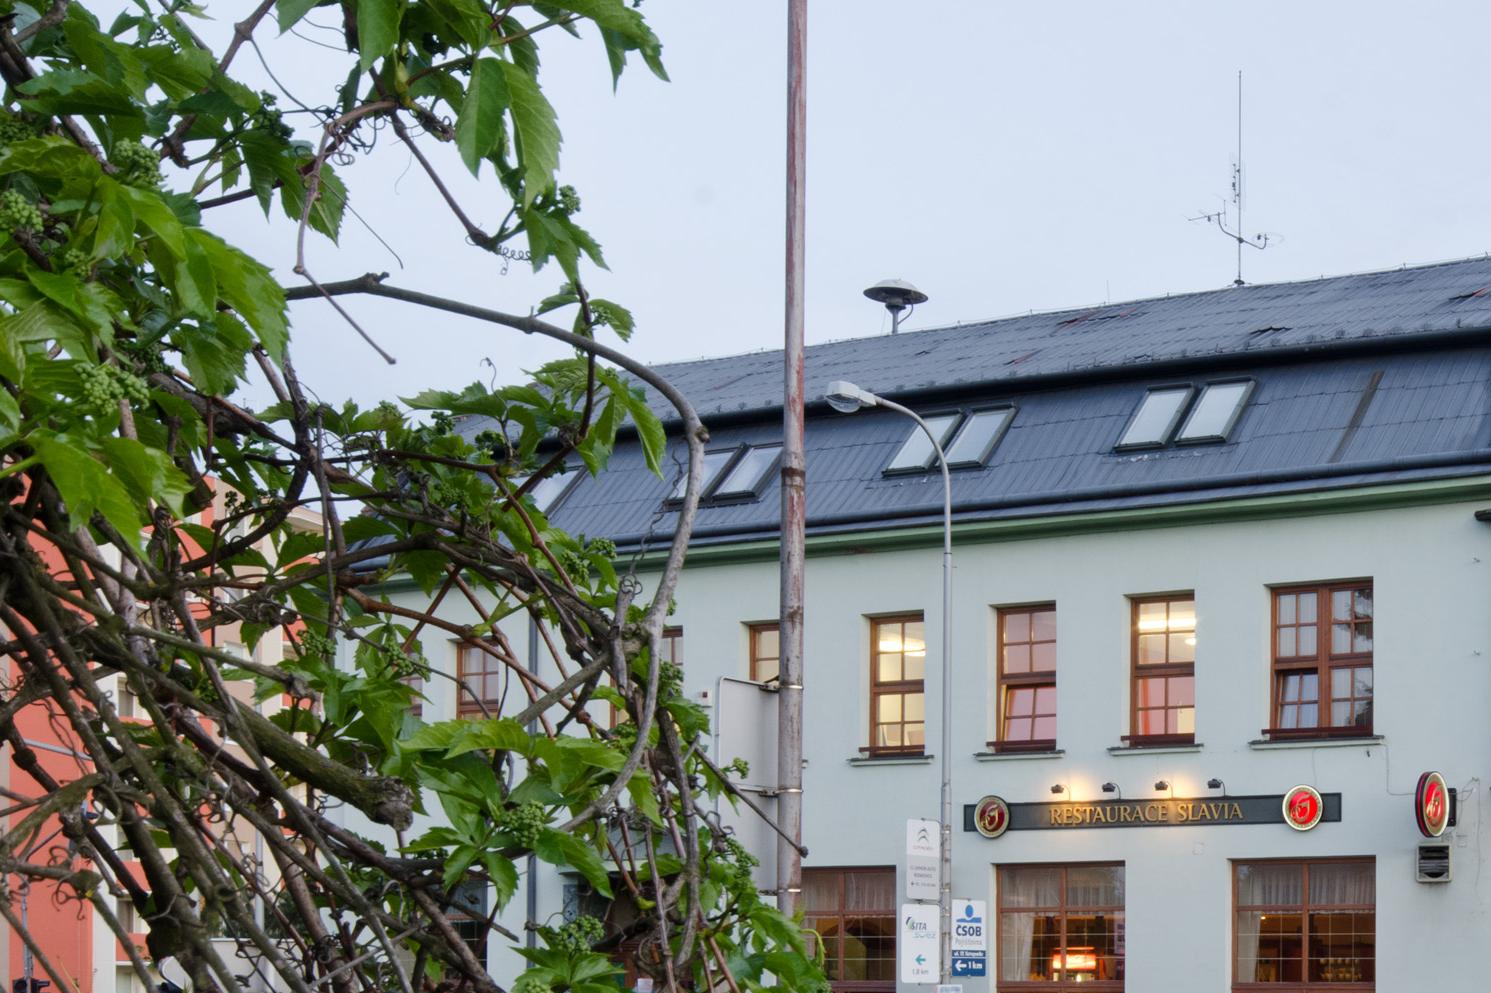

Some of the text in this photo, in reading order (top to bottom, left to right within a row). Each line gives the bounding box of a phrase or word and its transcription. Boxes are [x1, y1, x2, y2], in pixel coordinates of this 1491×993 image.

[1049, 802, 1244, 825] RESTAURACE SLAVIA
[955, 924, 982, 937] ČSOB
